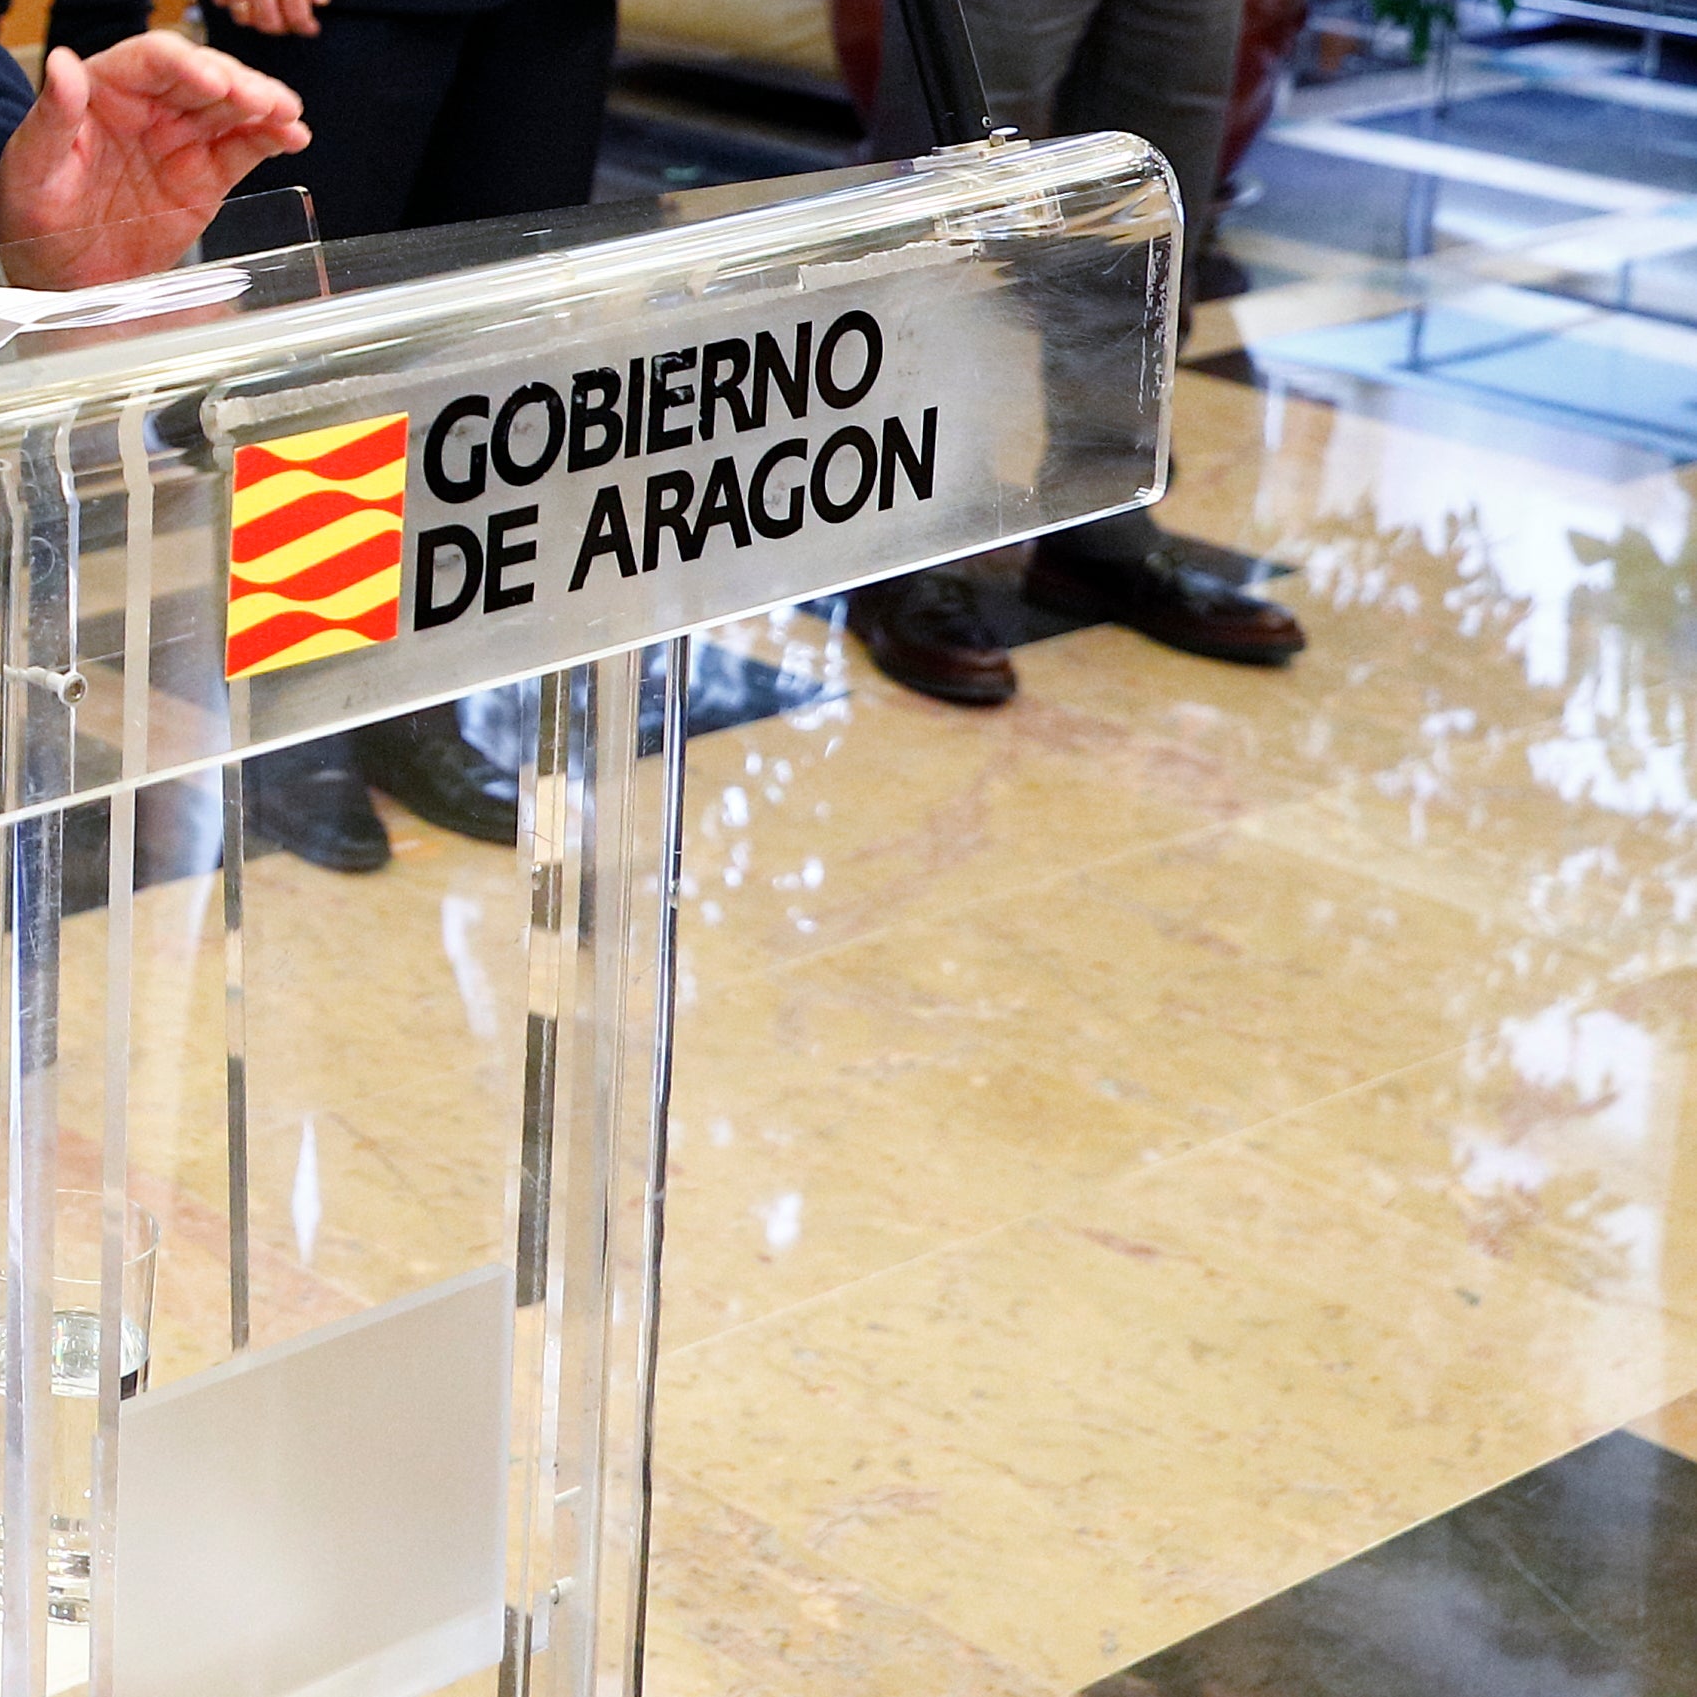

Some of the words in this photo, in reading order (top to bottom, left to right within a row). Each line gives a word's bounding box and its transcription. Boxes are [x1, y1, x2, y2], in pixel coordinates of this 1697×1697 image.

[422, 309, 884, 505] GOBIERNO
[413, 503, 539, 632] DE
[567, 406, 939, 593] ARAGON
